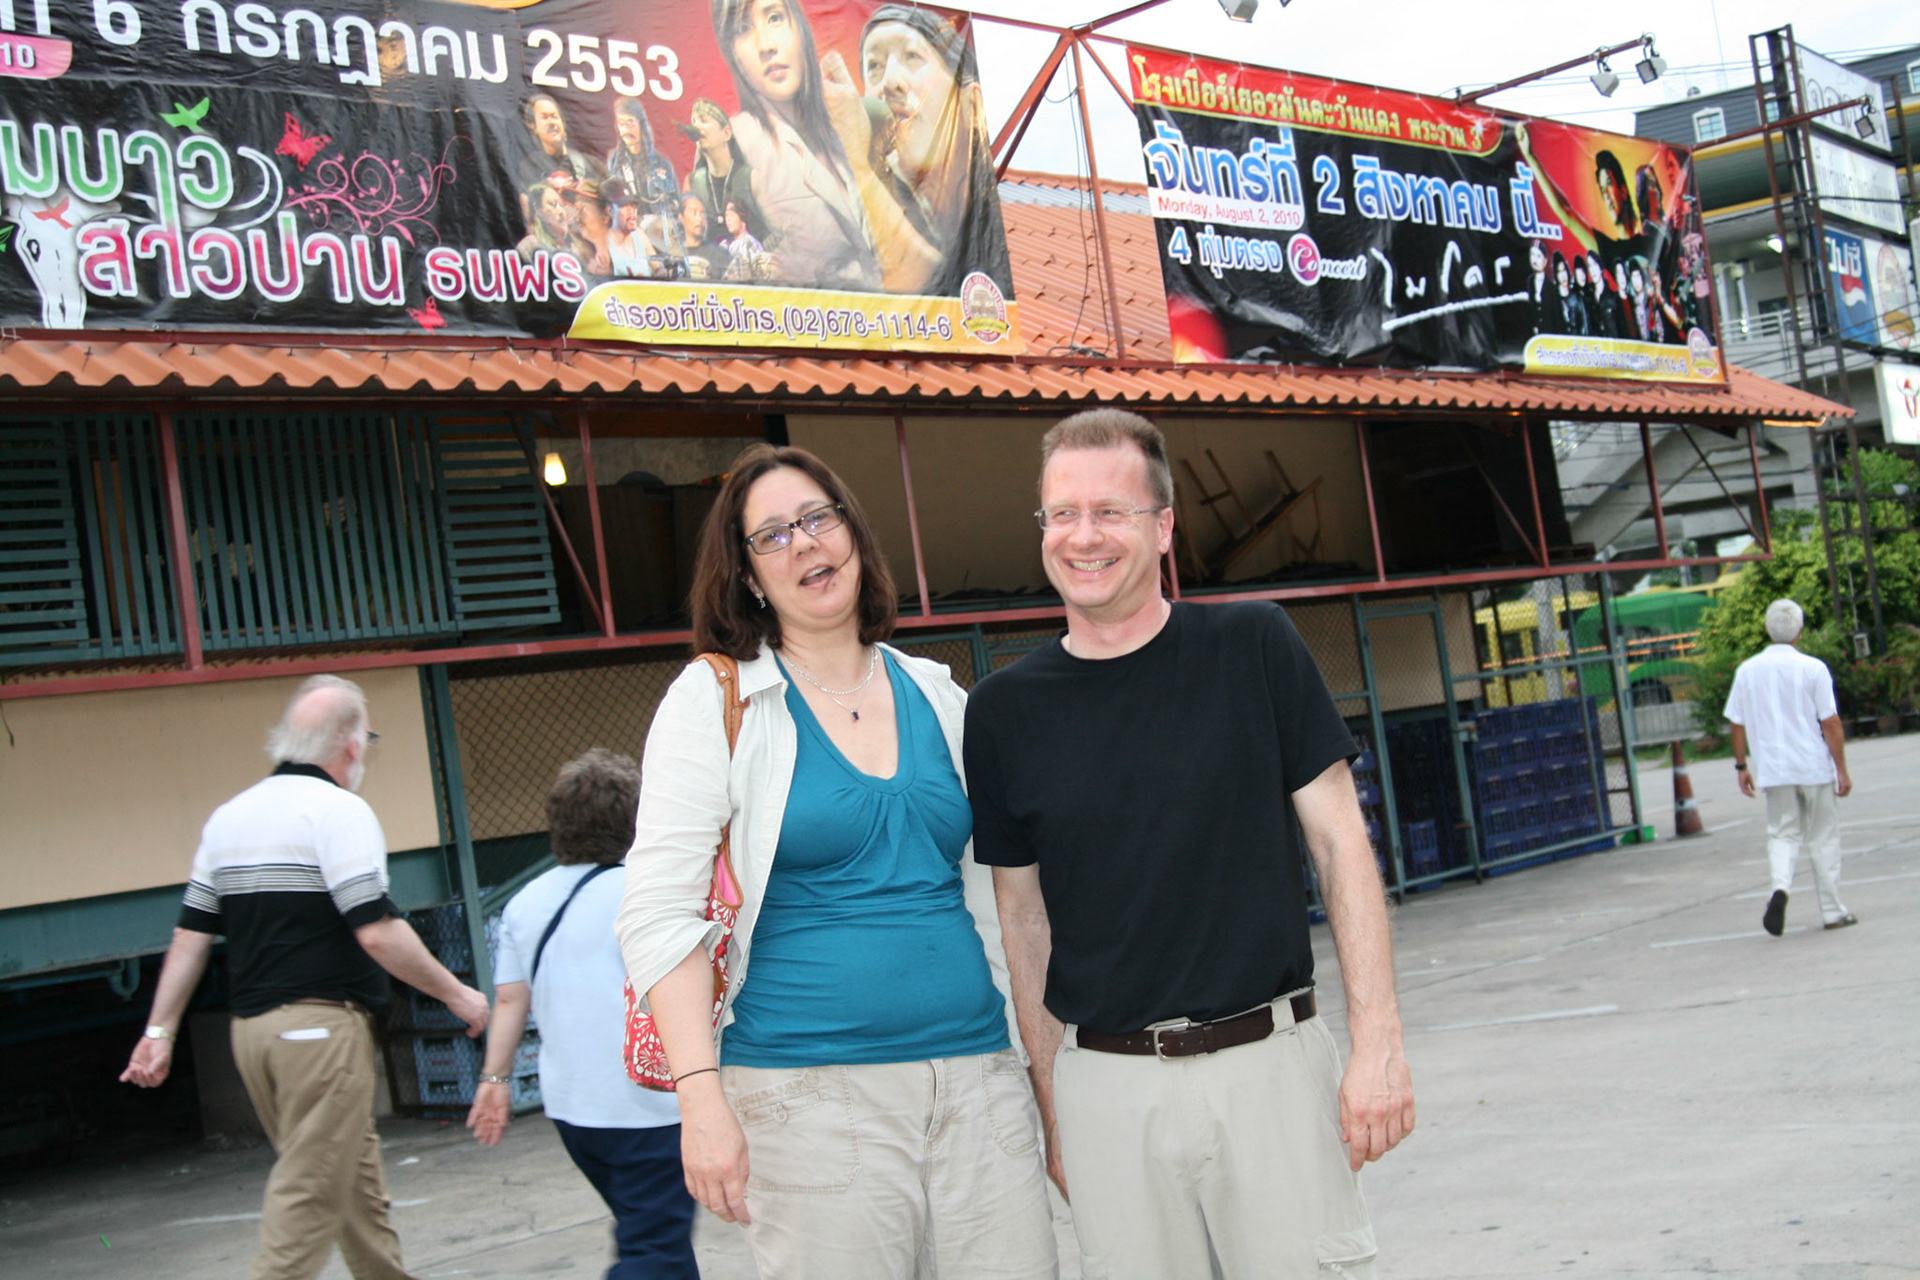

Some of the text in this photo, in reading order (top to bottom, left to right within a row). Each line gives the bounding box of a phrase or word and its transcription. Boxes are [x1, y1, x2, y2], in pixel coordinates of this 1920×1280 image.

[181, 0, 509, 87] กรกฎาคม
[526, 28, 684, 101] 2553
[1158, 196, 1212, 219] Monday,
[1216, 203, 1254, 224] August
[1273, 208, 1301, 226] 2010
[1312, 154, 1346, 215] 2
[1352, 154, 1501, 234] สิงหาคม
[1168, 226, 1192, 265] 4
[425, 246, 589, 303] ธนพร
